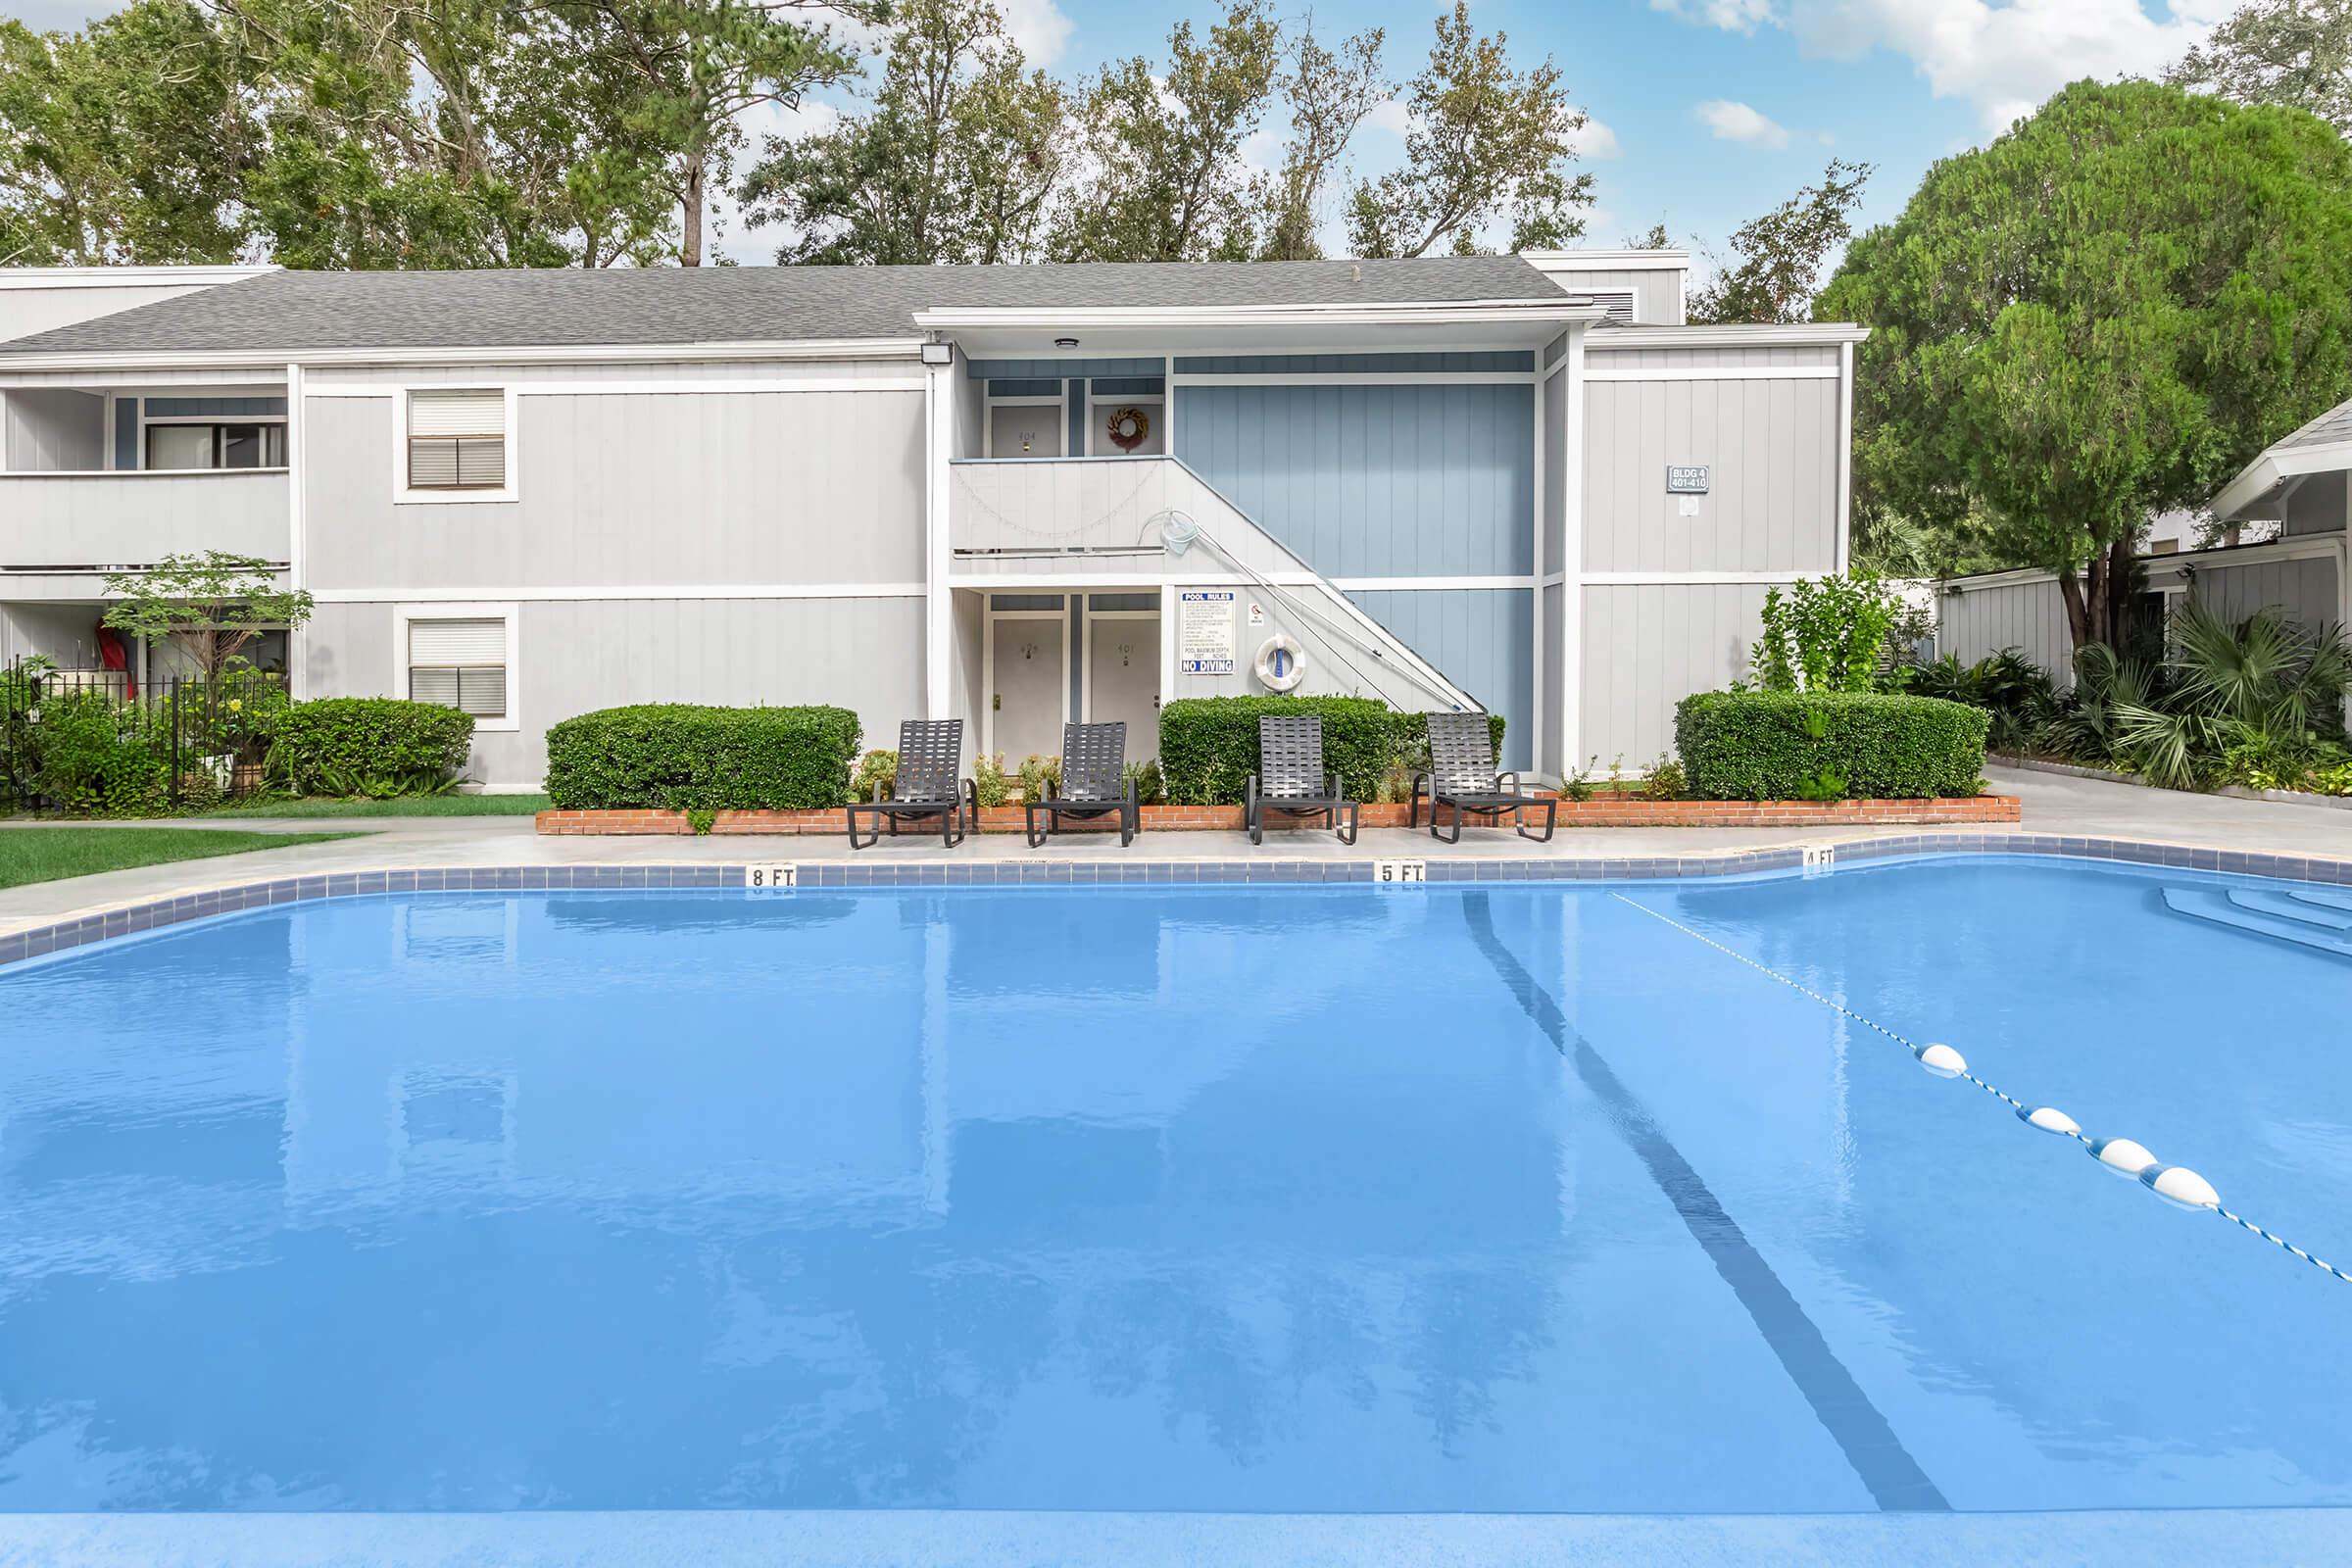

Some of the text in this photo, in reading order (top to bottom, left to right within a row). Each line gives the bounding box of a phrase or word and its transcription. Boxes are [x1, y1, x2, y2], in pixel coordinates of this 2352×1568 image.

[1673, 469, 1705, 478] BLDG 4
[1672, 477, 1706, 487] 401-410
[1183, 661, 1232, 671] NO DIVING
[753, 869, 794, 887] 8 FT.
[1382, 865, 1423, 882] 5 FT.
